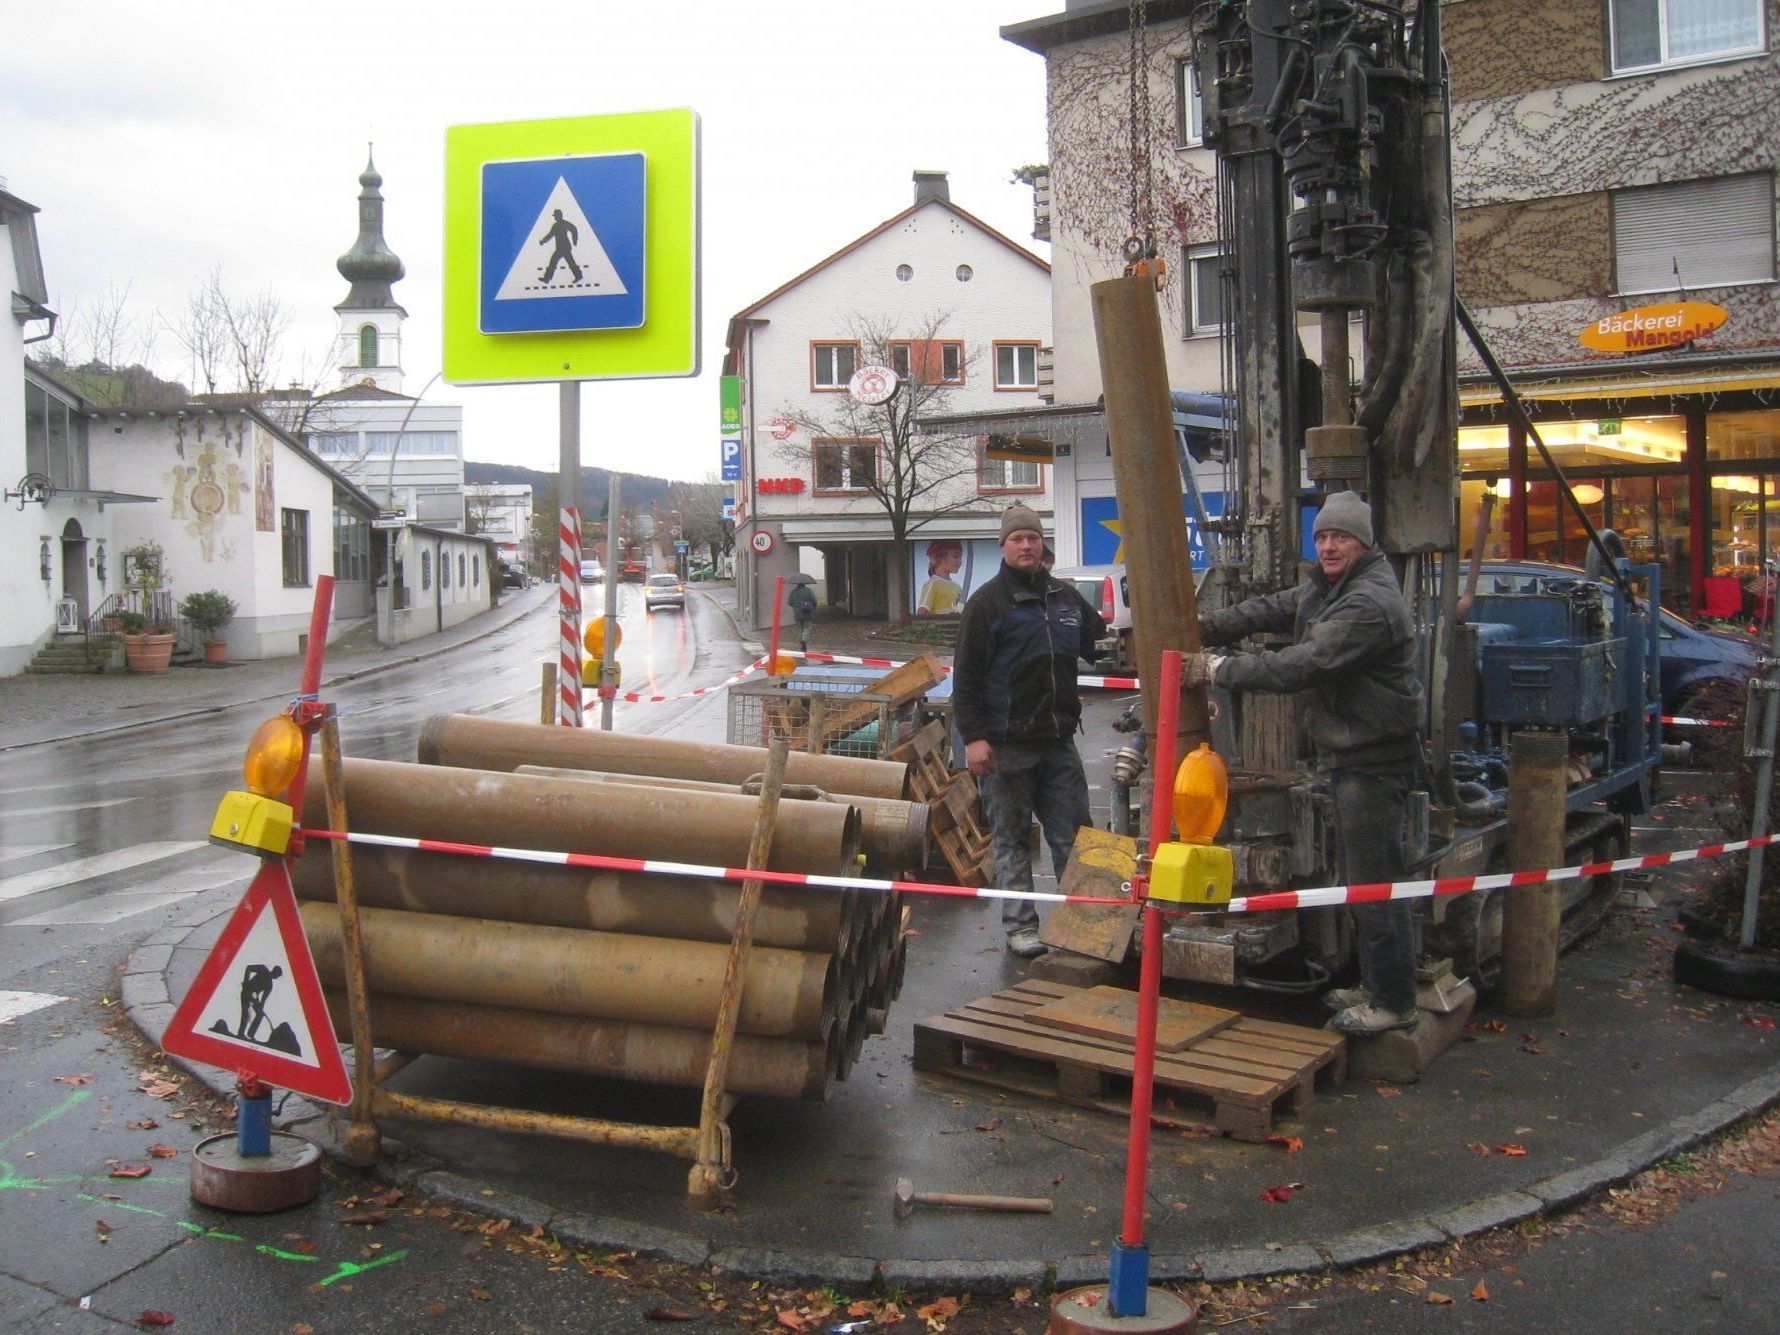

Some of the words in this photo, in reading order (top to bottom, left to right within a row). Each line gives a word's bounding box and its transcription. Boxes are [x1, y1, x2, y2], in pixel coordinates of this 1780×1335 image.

[1598, 310, 1684, 334] Bäckerei
[1625, 322, 1715, 347] Mangold
[723, 442, 739, 461] P
[755, 537, 765, 546] 40
